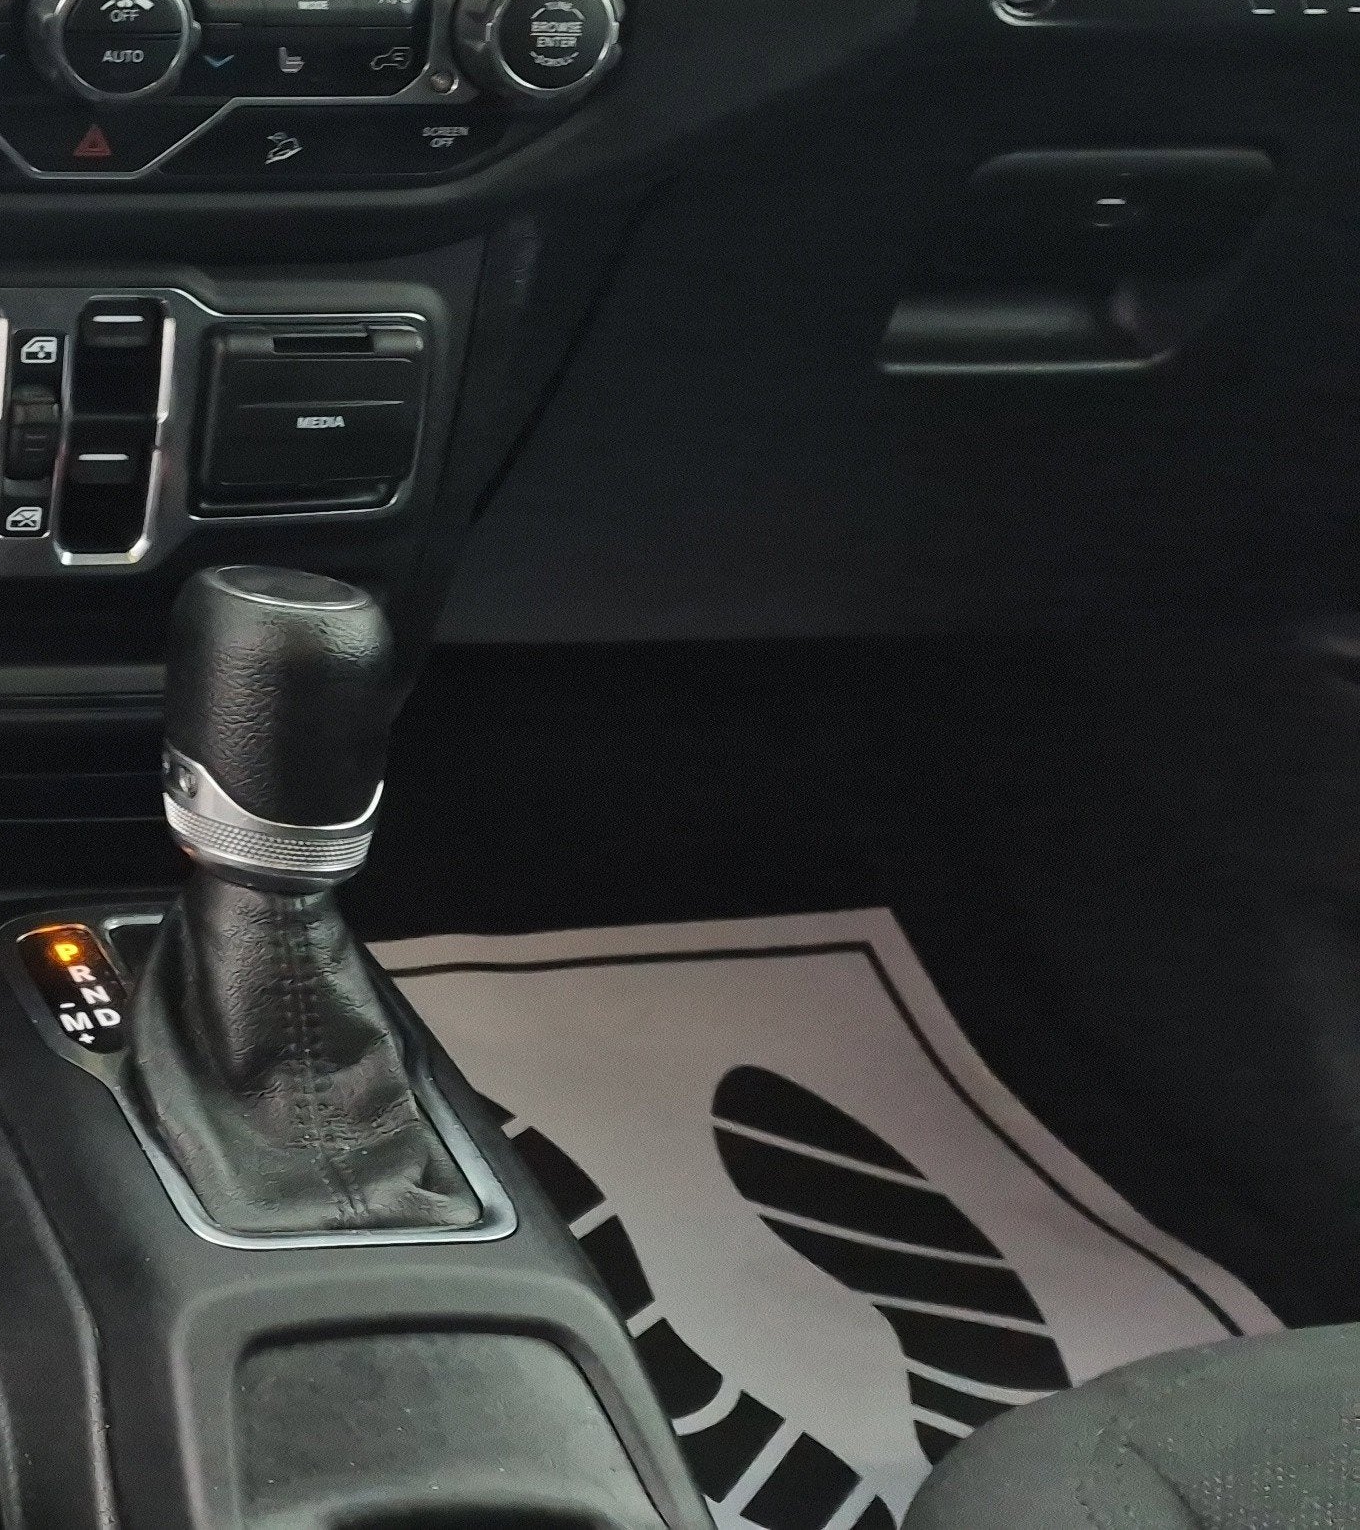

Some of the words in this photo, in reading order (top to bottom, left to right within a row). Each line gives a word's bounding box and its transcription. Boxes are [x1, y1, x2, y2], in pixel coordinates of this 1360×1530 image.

[109, 9, 141, 23] OFF
[536, 37, 578, 48] ENTER
[102, 49, 144, 64] AUTO
[422, 126, 469, 137] SCREEN
[429, 137, 456, 148] OFF
[296, 415, 346, 429] MEDIA
[54, 943, 79, 962] P
[67, 965, 97, 983] R
[80, 985, 111, 1004] N
[59, 1011, 94, 1032] M
[92, 1008, 121, 1027] D
